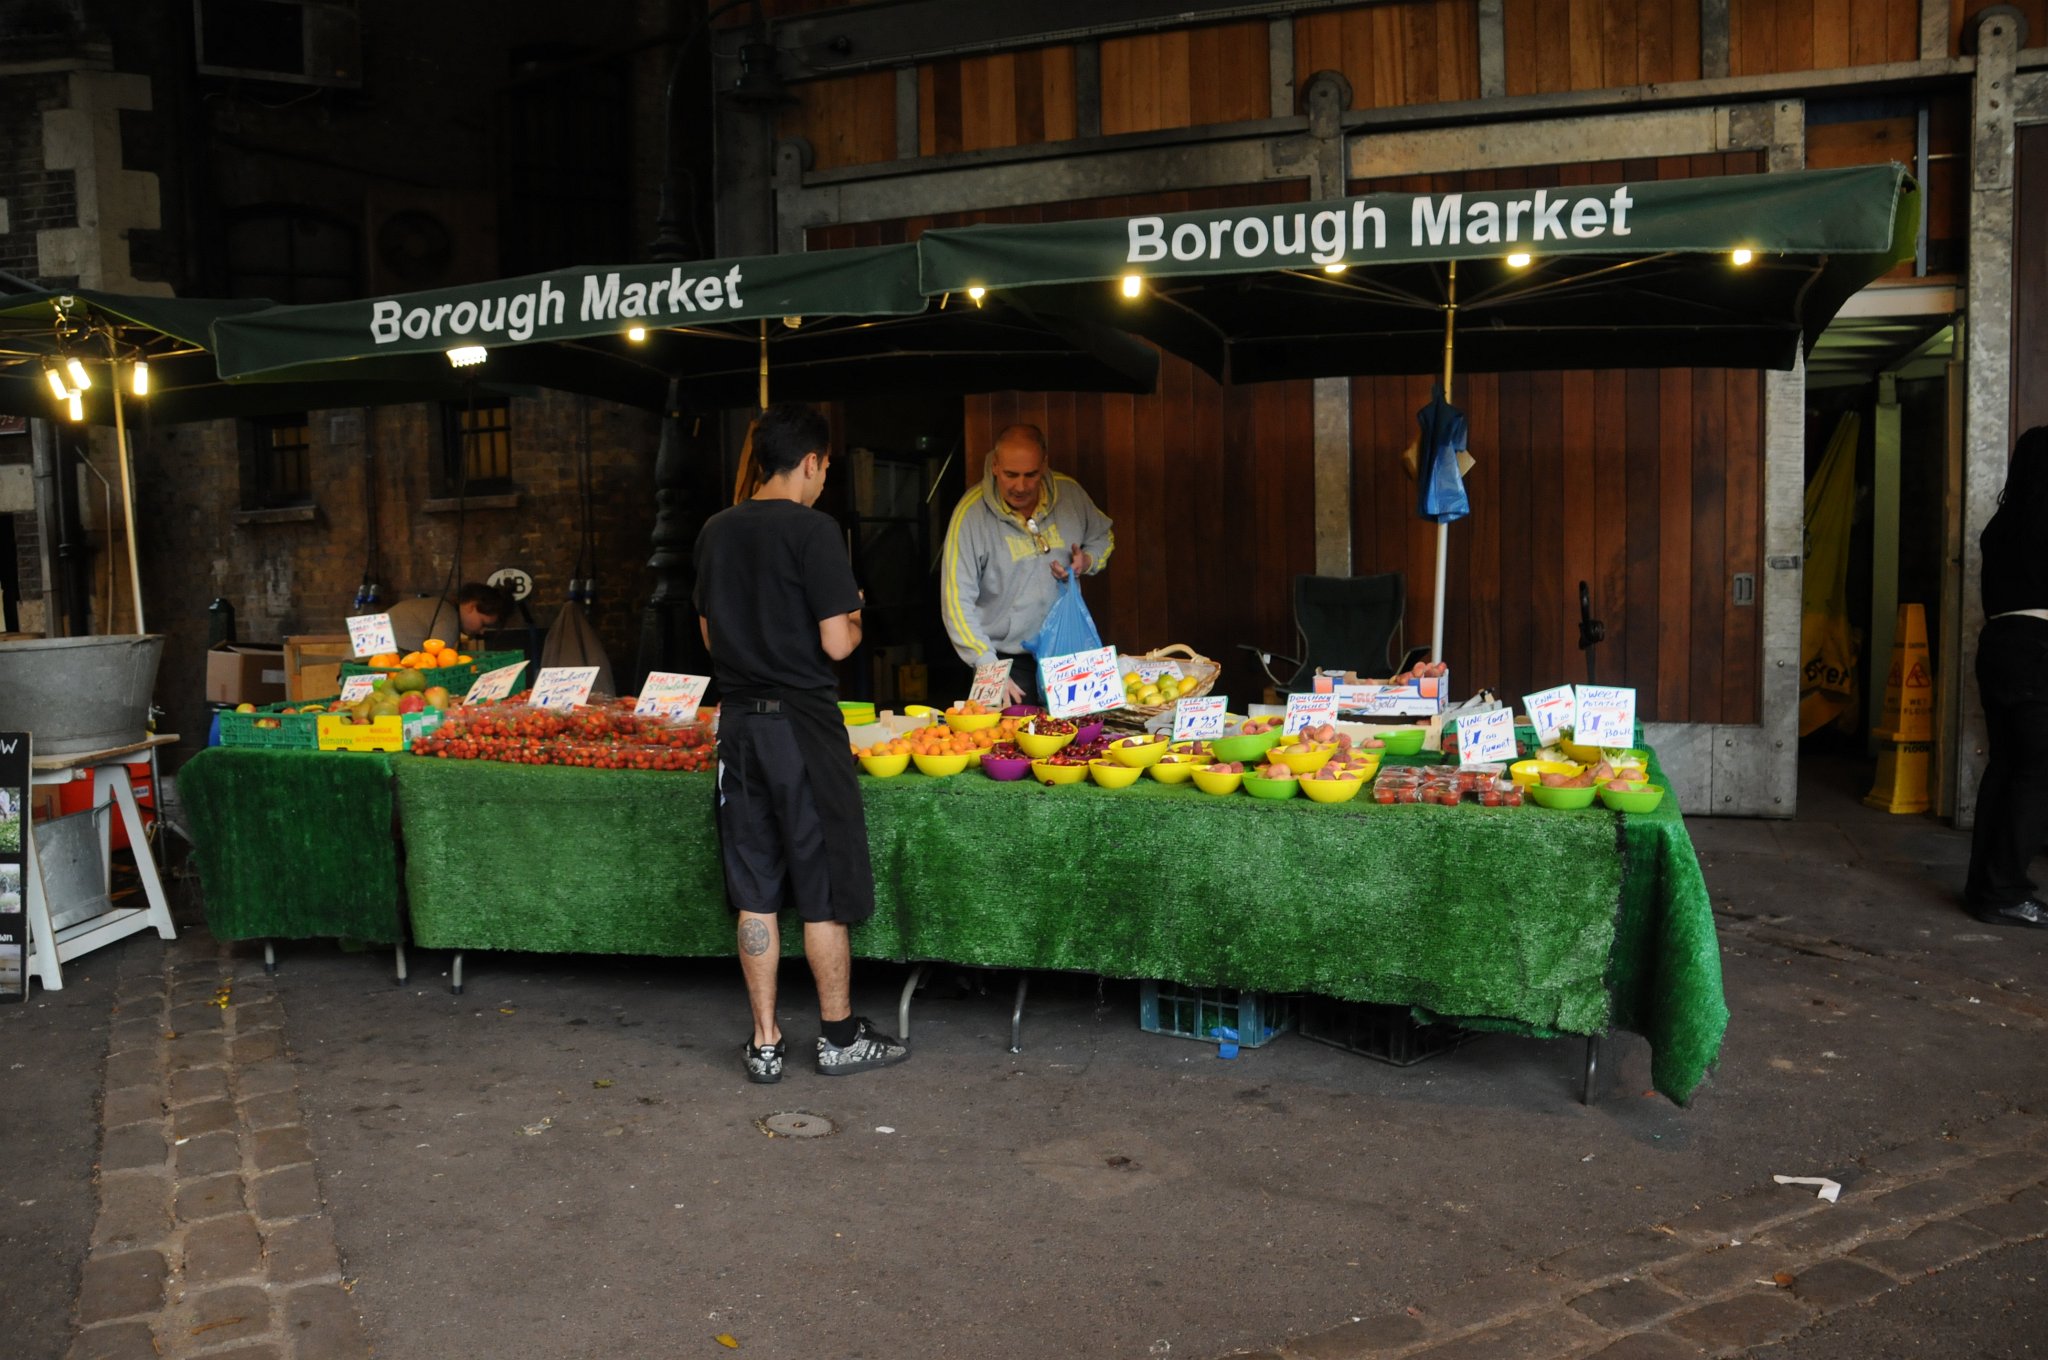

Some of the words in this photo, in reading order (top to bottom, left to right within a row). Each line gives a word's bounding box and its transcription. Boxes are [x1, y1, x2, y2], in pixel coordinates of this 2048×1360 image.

[1126, 201, 1387, 264] Borough
[1411, 186, 1634, 247] Market
[370, 279, 565, 344] Borough
[580, 264, 744, 322] Market
